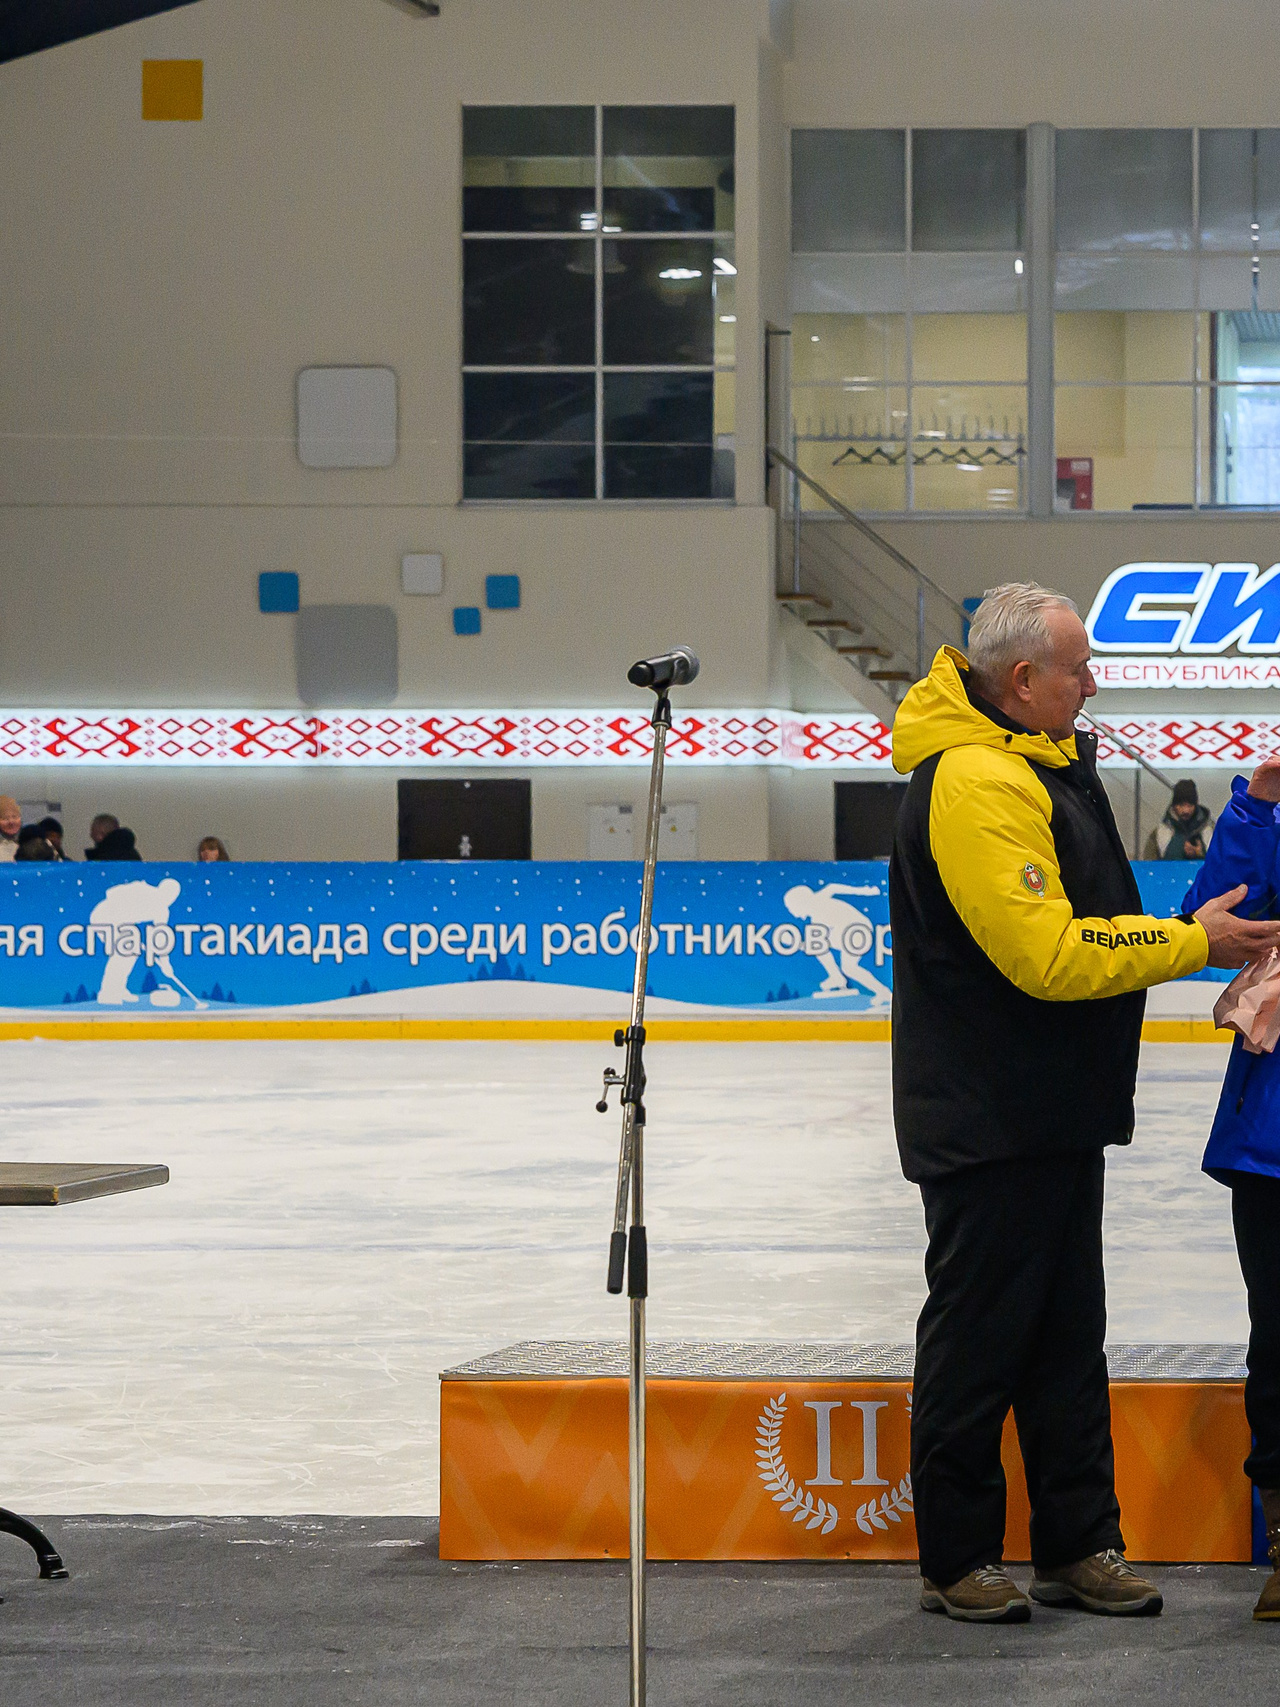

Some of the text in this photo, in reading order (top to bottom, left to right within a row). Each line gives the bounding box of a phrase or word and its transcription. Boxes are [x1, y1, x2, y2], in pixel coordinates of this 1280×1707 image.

[58, 923, 369, 966] спартакиада
[382, 923, 527, 966] среди
[541, 910, 830, 966] работников
[1081, 928, 1170, 951] BELARUS
[803, 1401, 889, 1486] II
